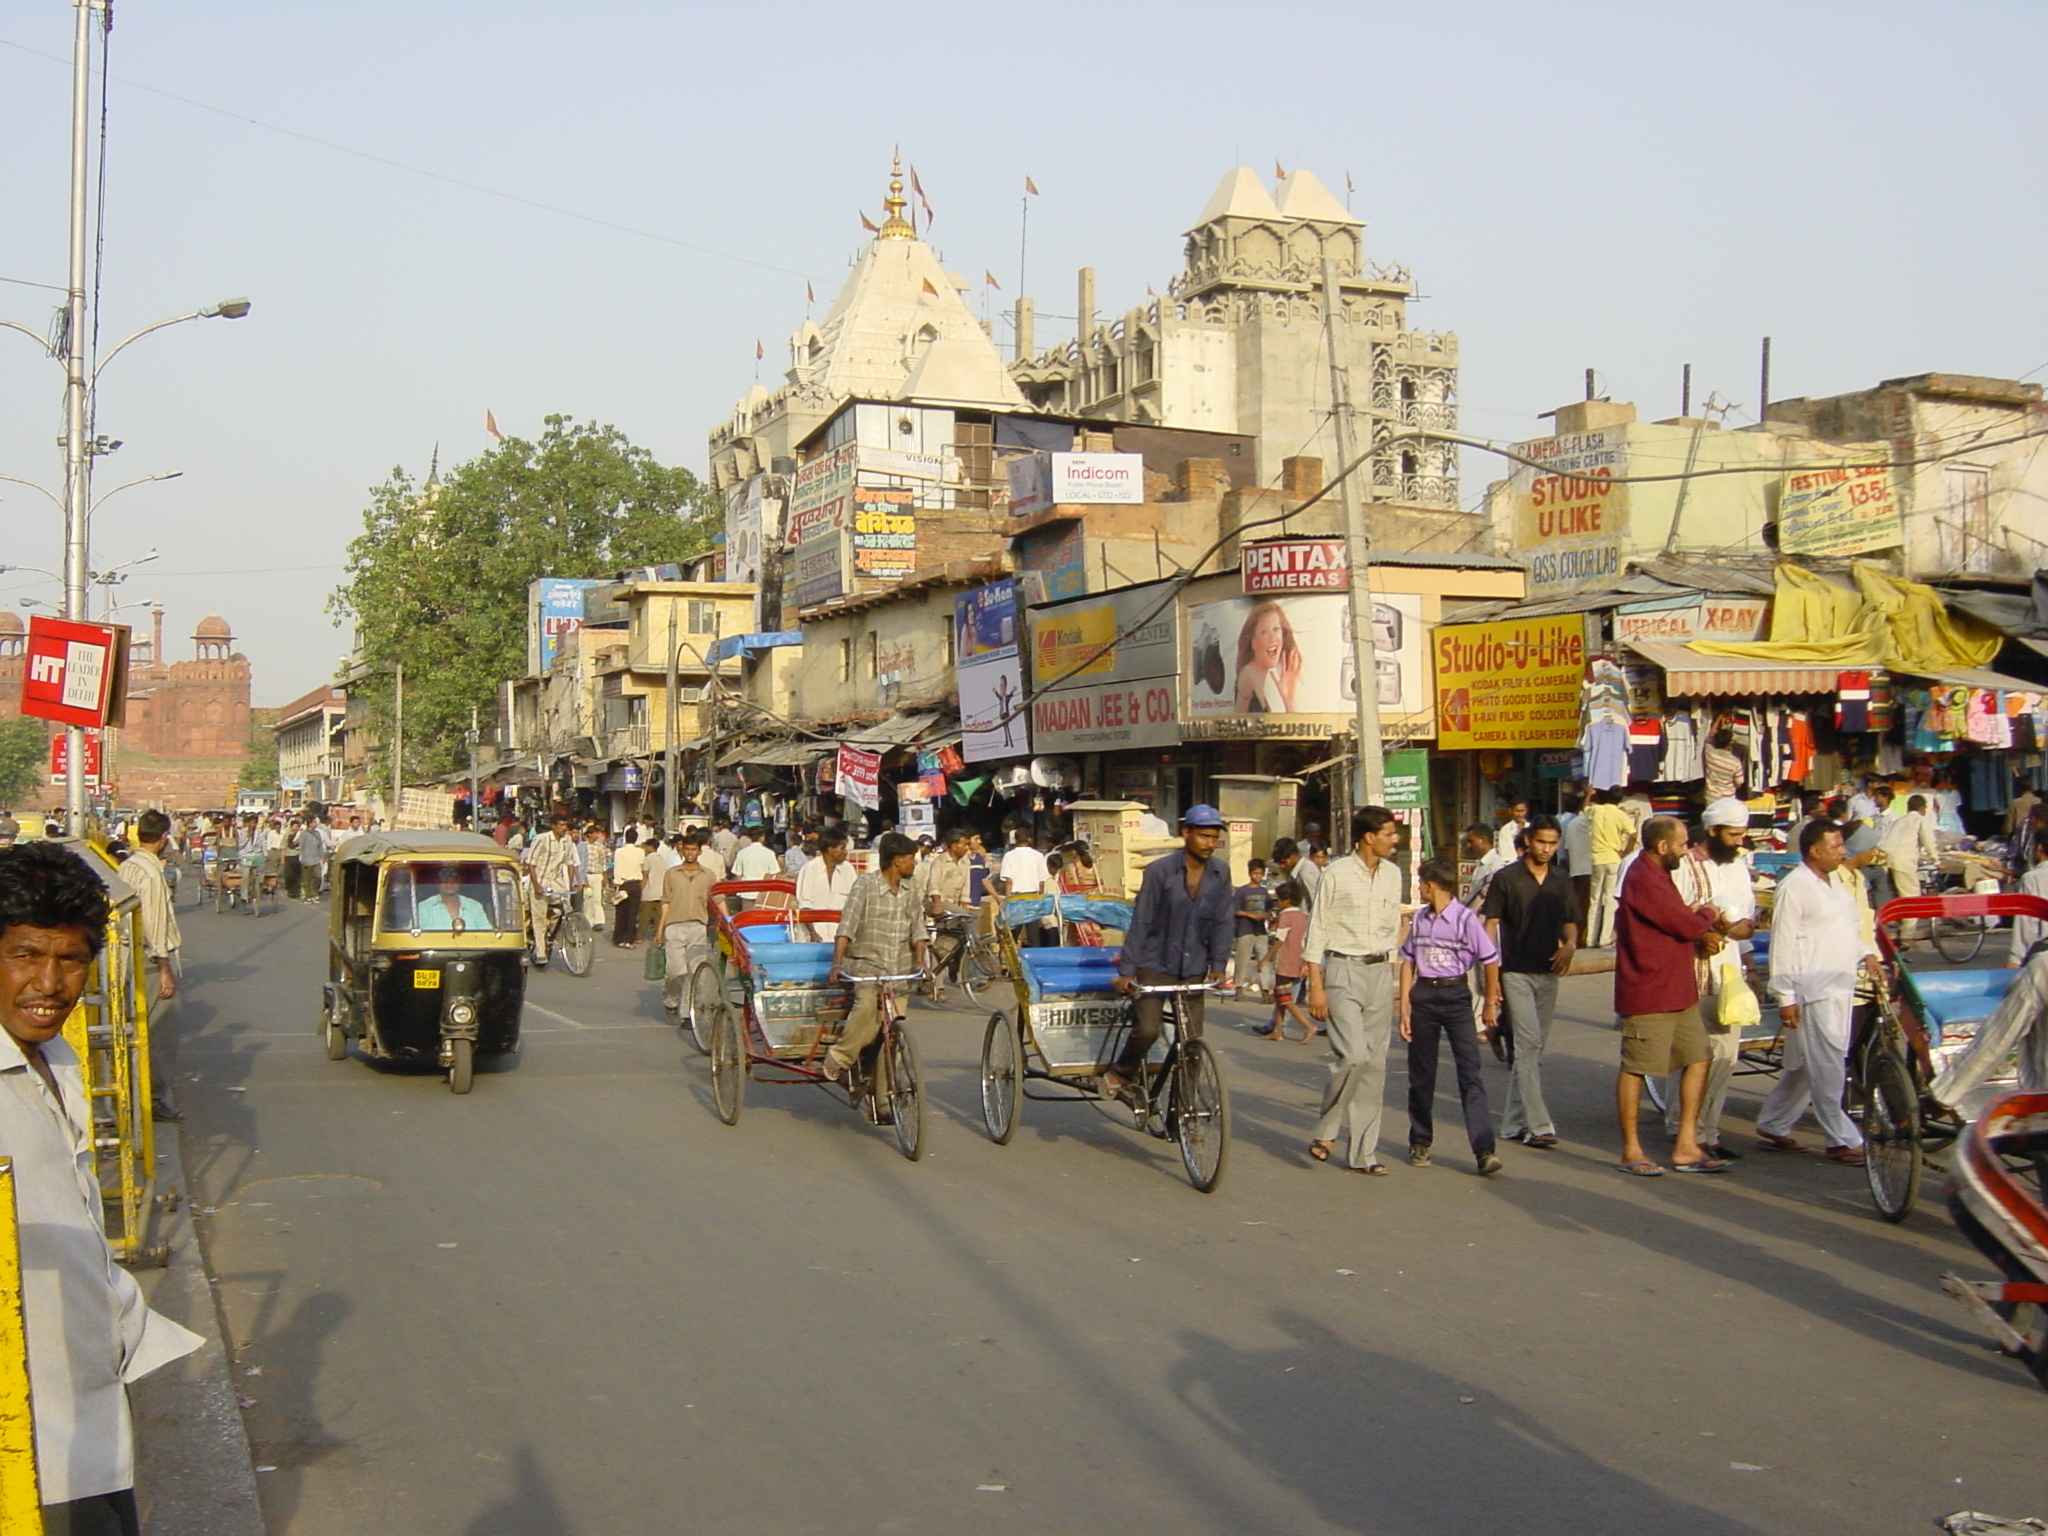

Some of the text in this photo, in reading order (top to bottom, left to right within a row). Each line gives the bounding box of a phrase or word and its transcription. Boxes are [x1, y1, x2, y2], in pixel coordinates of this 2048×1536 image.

[1518, 439, 1560, 460] CAMERA
[1572, 433, 1604, 453] FLASH
[906, 454, 942, 465] VISION
[1067, 466, 1129, 479] Indicom
[1790, 468, 1850, 491] FESTIVAL
[1531, 466, 1612, 506] STUDIO
[1539, 503, 1602, 537] U LIKE
[1246, 544, 1346, 574] PENTAX
[1560, 549, 1594, 579] COLOR
[1596, 547, 1618, 575] LAB
[1252, 573, 1340, 589] CAMERAS
[545, 616, 585, 637] LUX
[1620, 618, 1692, 637] MEDICAL
[77, 651, 93, 662] THE
[1440, 626, 1582, 674] Studio-U-Like
[31, 654, 65, 684] HT
[68, 662, 100, 676] LEADER
[78, 676, 87, 688] IN
[1471, 678, 1499, 690] KODAK
[1534, 674, 1577, 686] CAMERAS
[68, 688, 95, 702] DELHI
[1472, 692, 1575, 707] PHOTO GOODS DEALERS
[1035, 688, 1175, 733] MADAN JEE & CO.
[1500, 710, 1525, 722] FILMS
[1529, 709, 1566, 721] COLOUR
[1568, 708, 1580, 720] LA
[1473, 730, 1507, 742] CAMERA
[1510, 729, 1516, 741] &
[1519, 729, 1547, 741] FLASH
